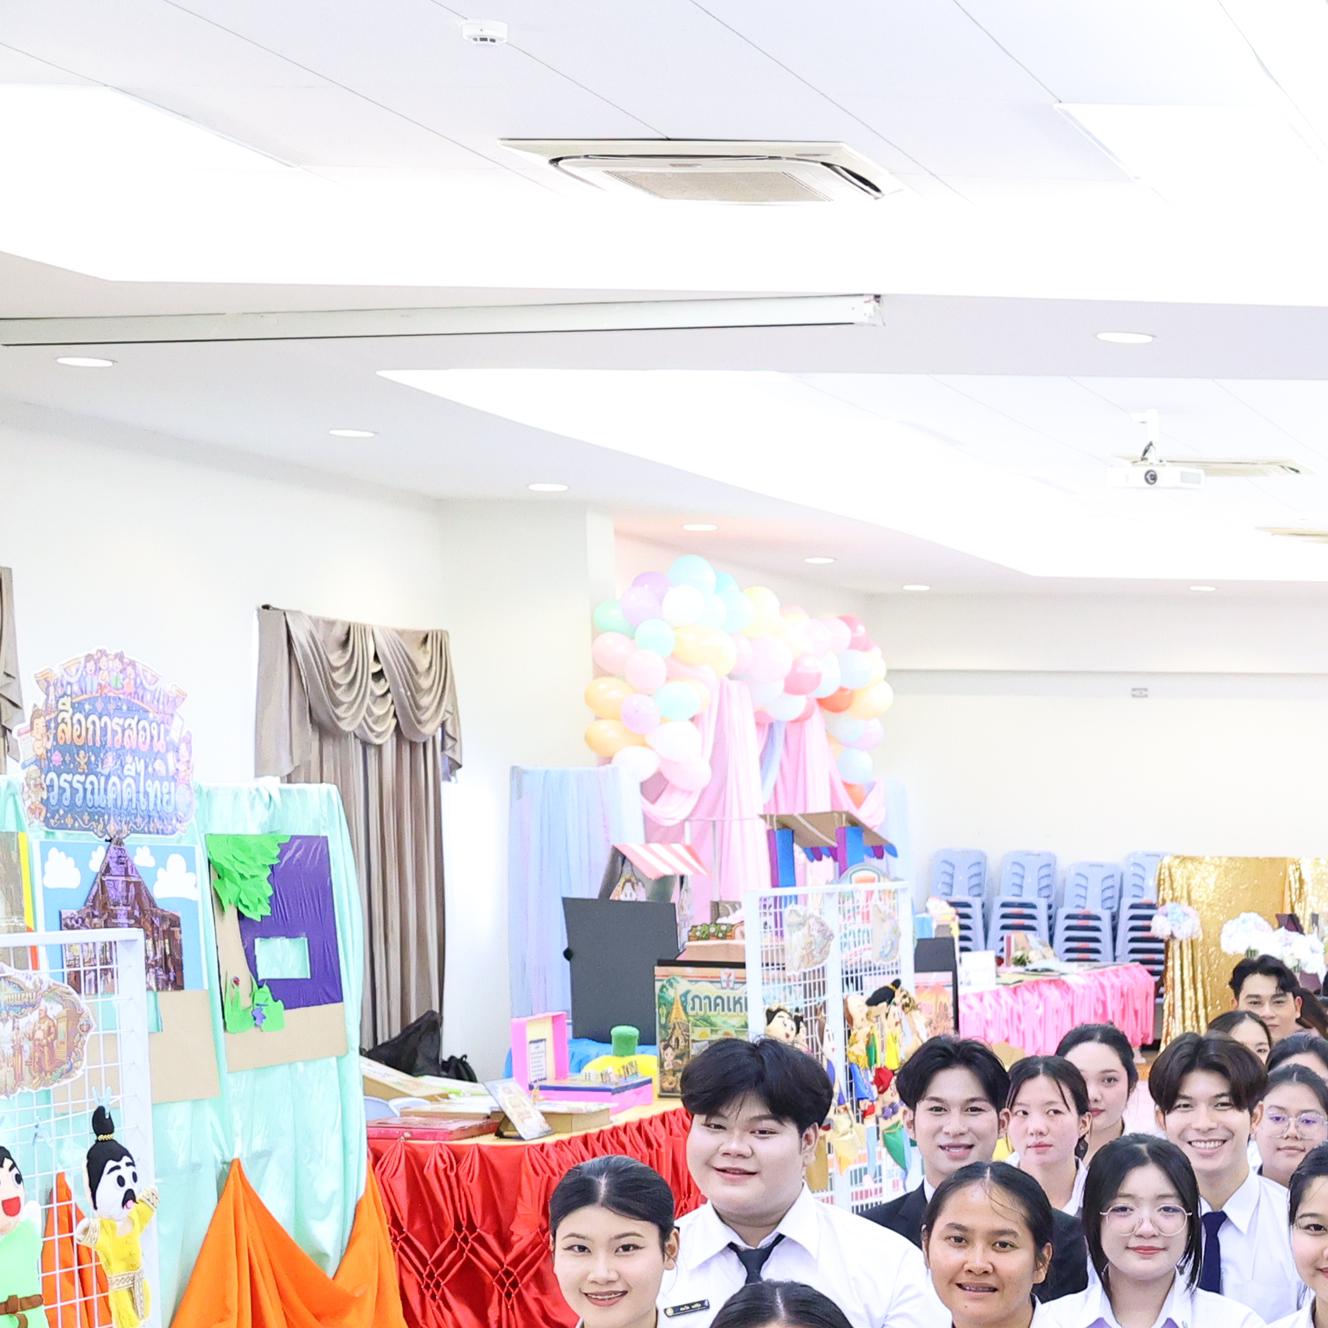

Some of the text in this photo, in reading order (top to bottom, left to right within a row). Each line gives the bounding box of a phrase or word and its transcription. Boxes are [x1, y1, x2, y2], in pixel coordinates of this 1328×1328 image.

[56, 683, 167, 752] สื่อการสอน
[45, 757, 177, 813] วรรณคดีไทย
